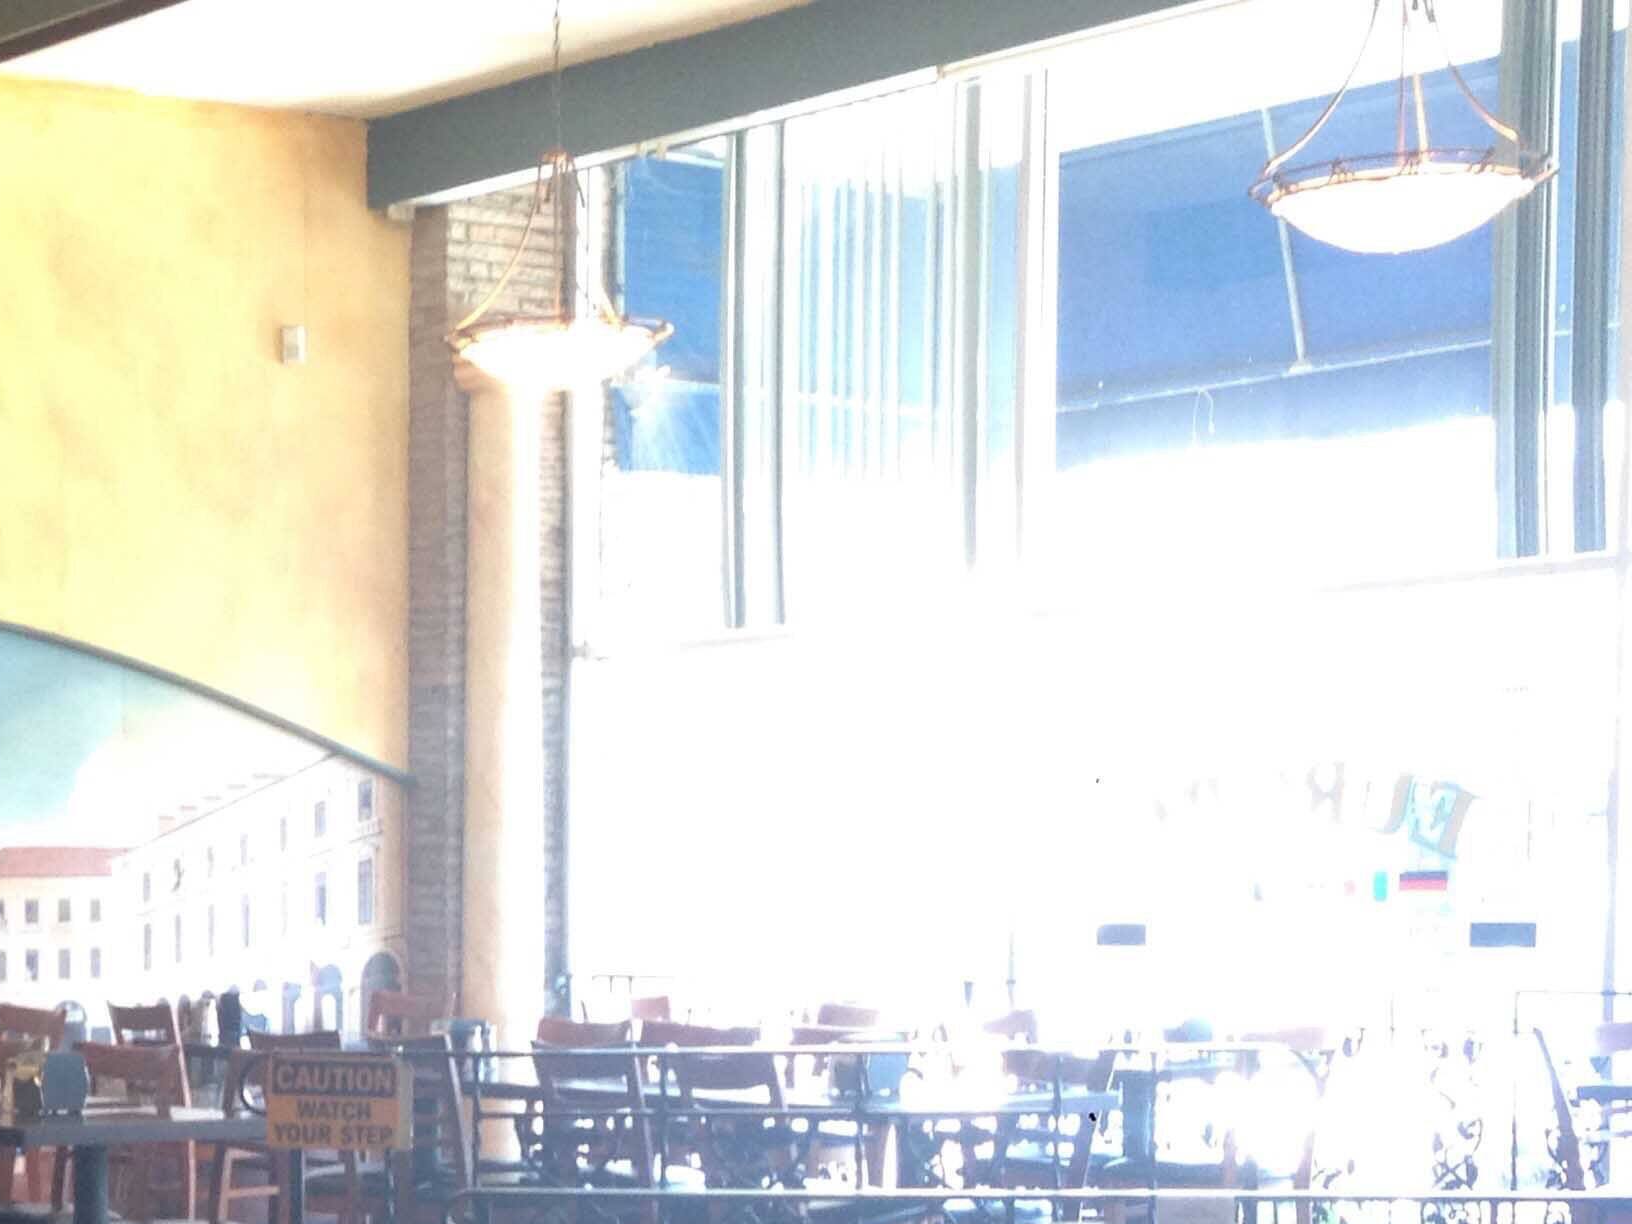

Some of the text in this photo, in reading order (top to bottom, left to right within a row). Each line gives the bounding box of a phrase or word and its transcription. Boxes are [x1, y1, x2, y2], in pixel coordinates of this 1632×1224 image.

[276, 1065, 393, 1090] CAUTION
[297, 1101, 372, 1120] WATCH
[273, 1123, 393, 1145] YOUR STEP
